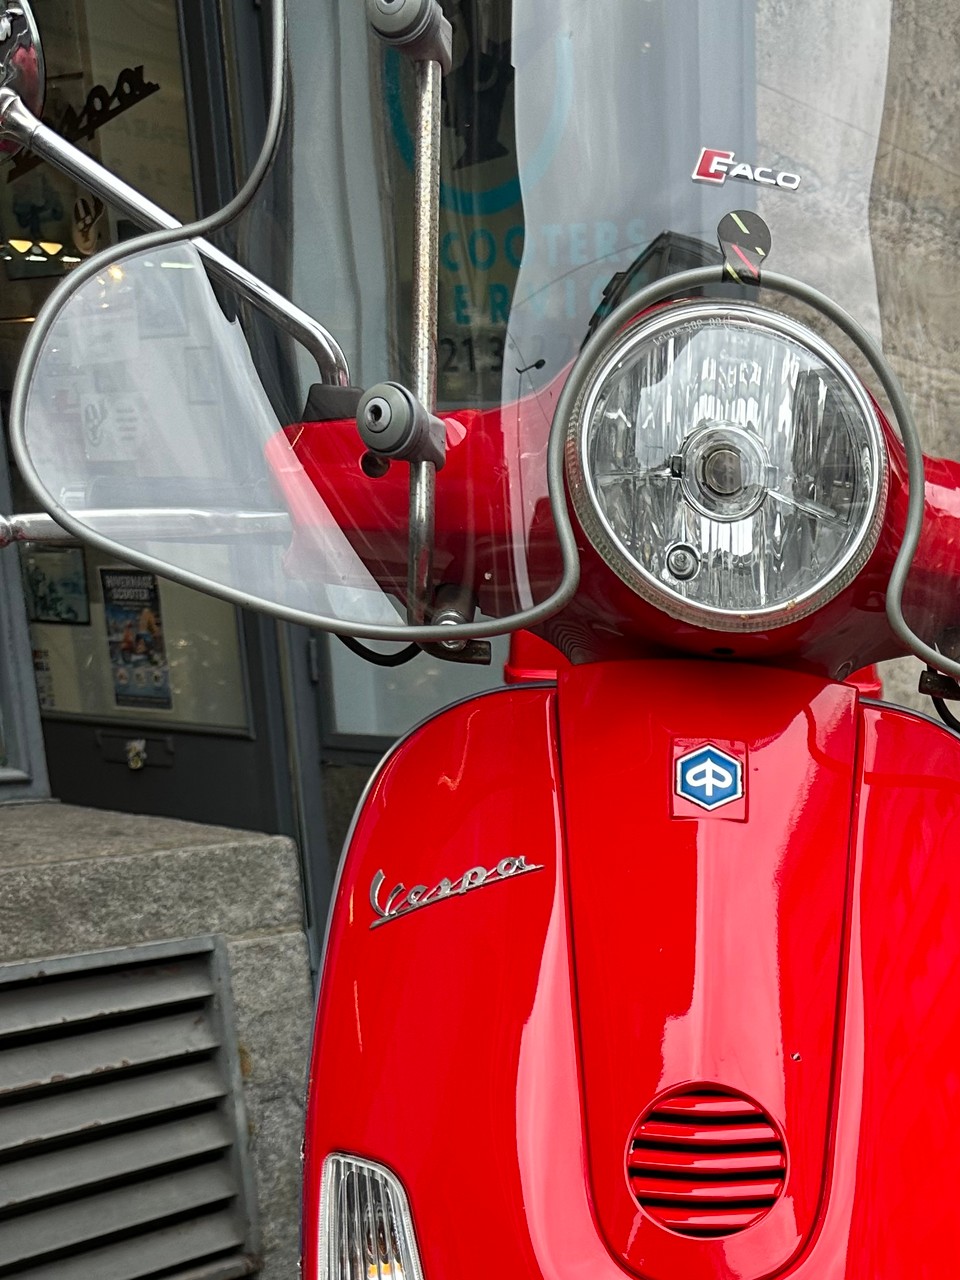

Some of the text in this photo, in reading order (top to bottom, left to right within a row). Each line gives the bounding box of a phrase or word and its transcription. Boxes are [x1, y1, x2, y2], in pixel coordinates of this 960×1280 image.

[691, 146, 802, 190] FACO
[440, 218, 648, 273] COOTERS
[368, 855, 546, 931] Vespa
